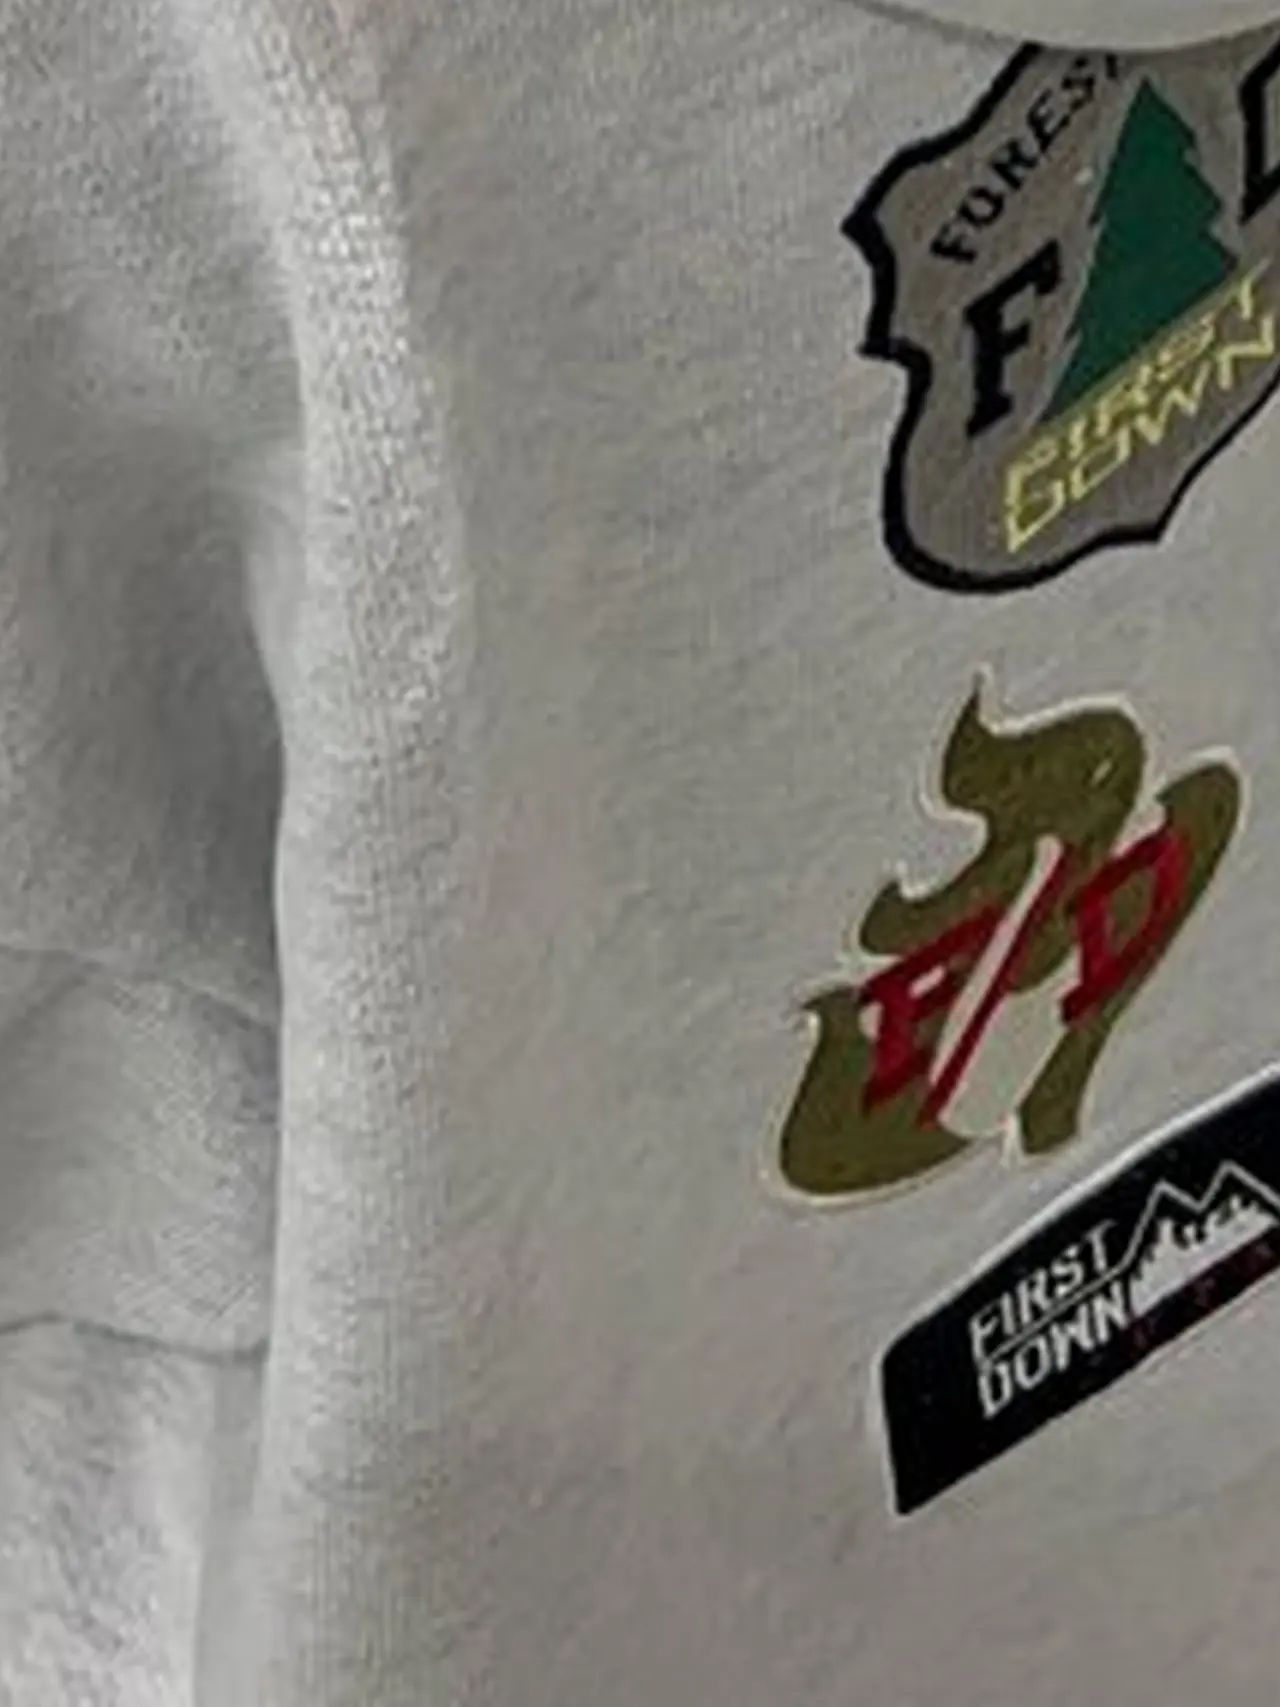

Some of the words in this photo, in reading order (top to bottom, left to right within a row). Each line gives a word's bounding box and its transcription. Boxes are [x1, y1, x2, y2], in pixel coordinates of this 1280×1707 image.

[963, 237, 1062, 440] F
[1005, 312, 1277, 553] DOWN
[967, 1218, 1120, 1364] FIRST
[975, 1282, 1131, 1421] DOWN
